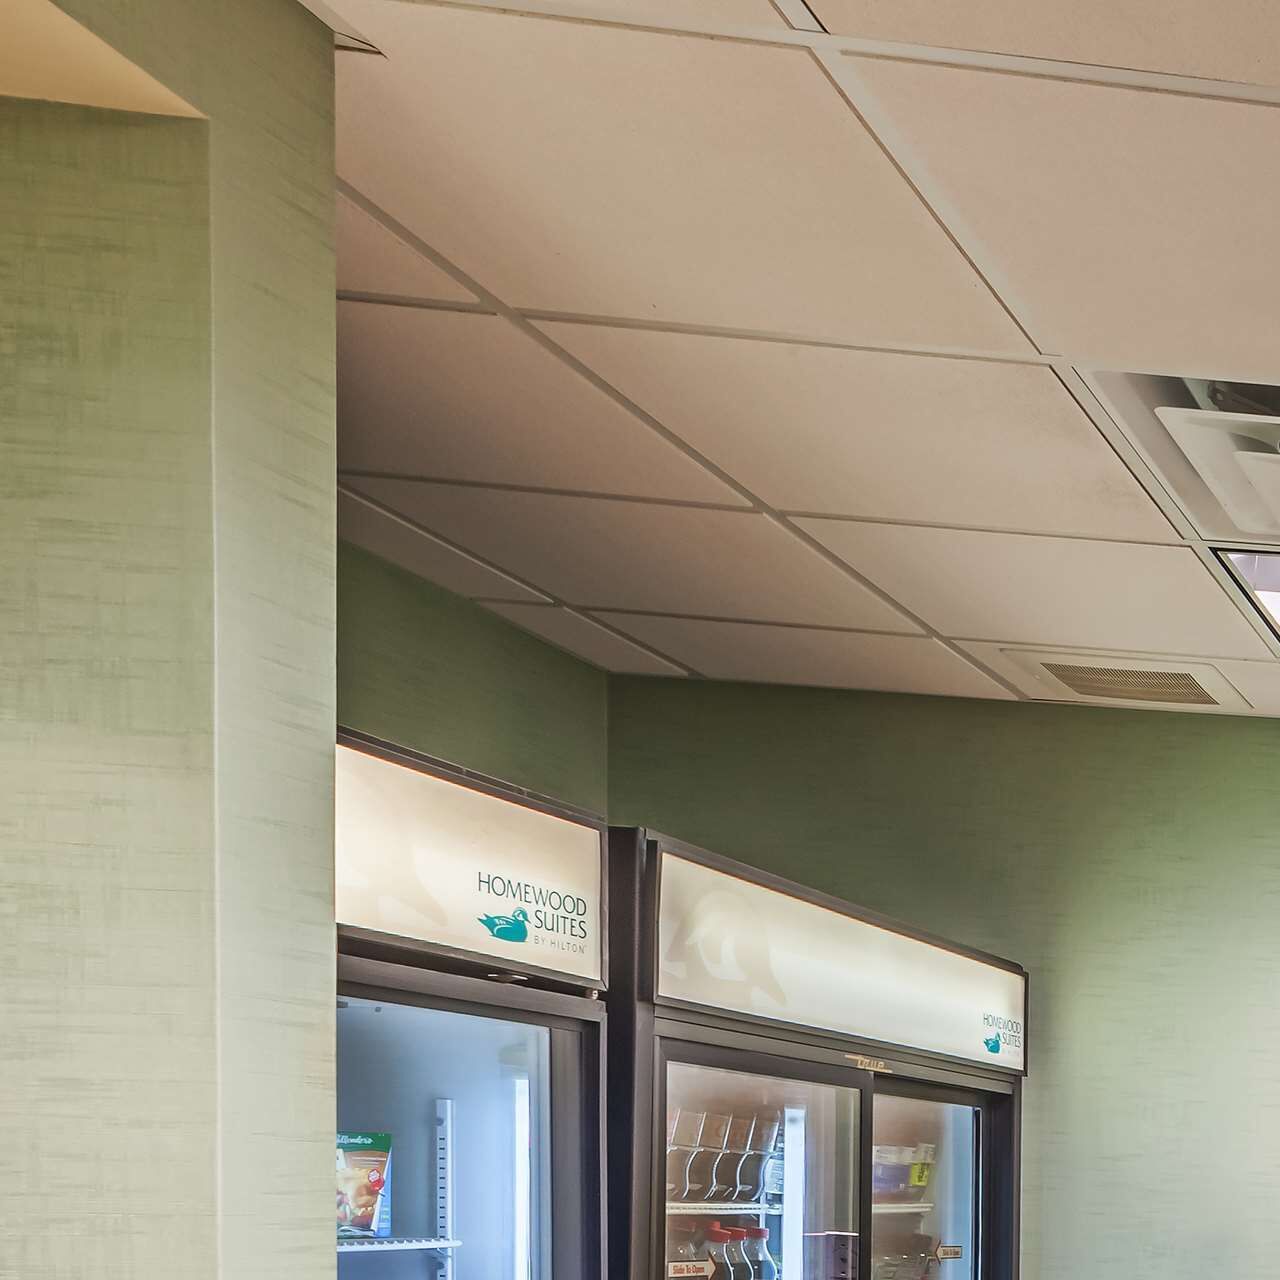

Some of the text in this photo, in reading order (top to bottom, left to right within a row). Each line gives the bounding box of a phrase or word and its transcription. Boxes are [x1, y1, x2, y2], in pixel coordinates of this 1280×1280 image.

[478, 871, 587, 916] HOMEWOOD
[534, 909, 587, 939] SUITES
[534, 935, 585, 954] BY HILTON
[983, 1012, 1022, 1034] HOMEWOOD
[1001, 1031, 1022, 1048] SUITES
